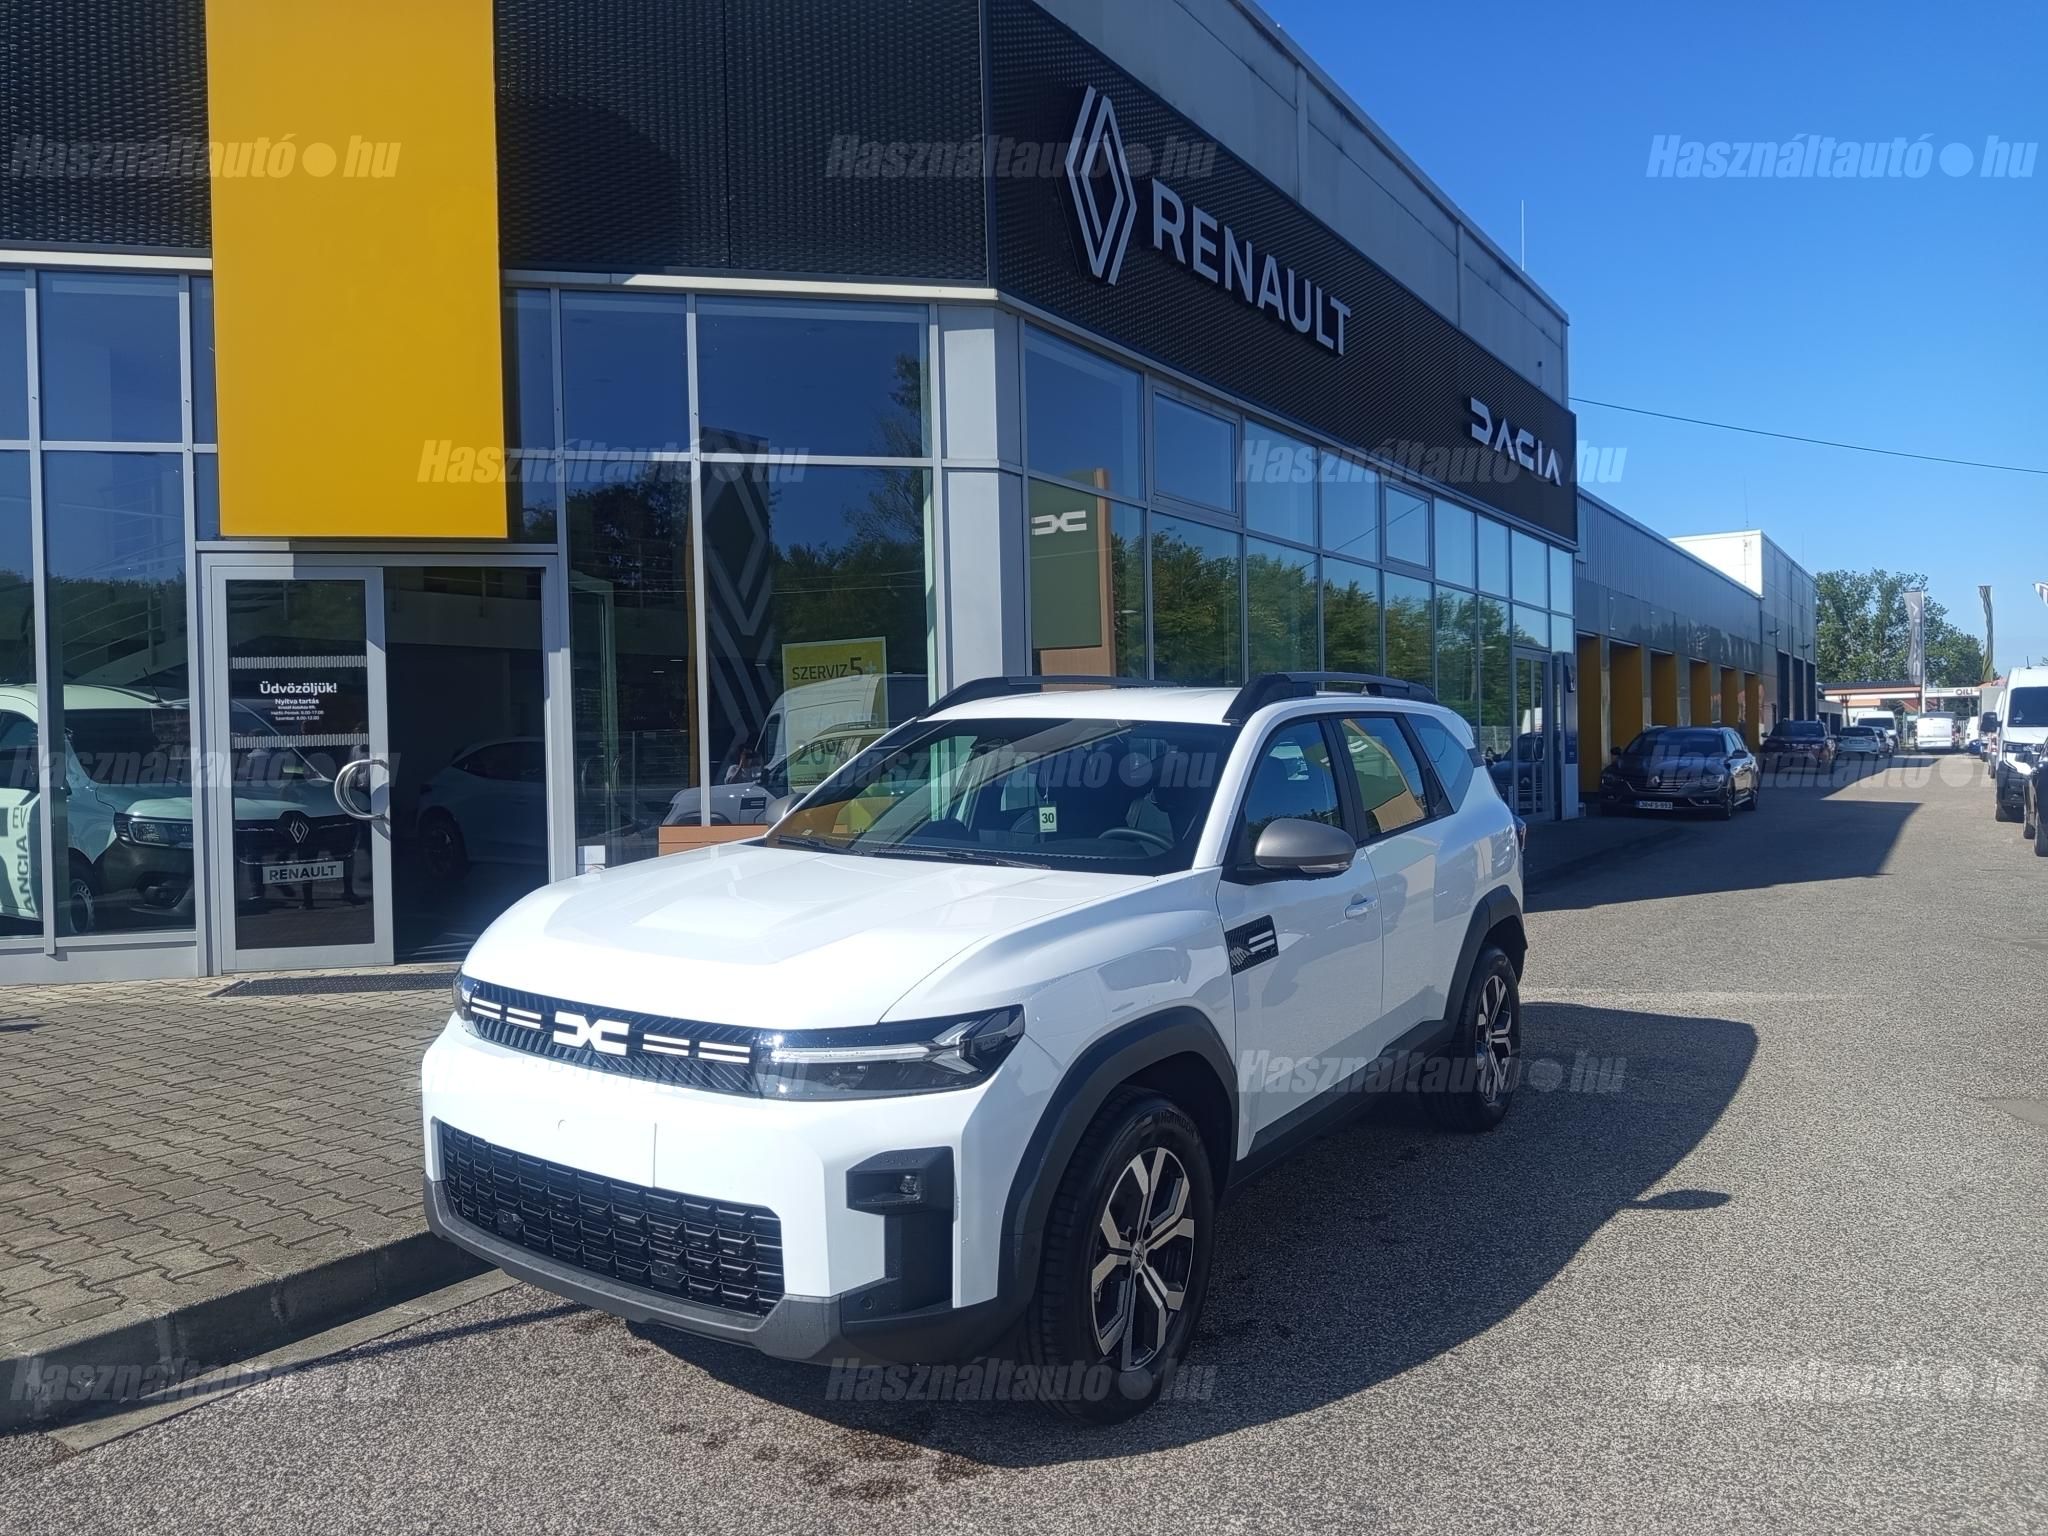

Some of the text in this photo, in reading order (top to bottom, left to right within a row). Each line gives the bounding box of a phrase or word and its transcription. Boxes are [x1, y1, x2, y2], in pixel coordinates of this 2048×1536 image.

[1152, 177, 1351, 355] RENAULT
[1471, 397, 1561, 487] DACIA
[792, 663, 848, 681] SZERVIZ
[260, 681, 337, 696] Üdvözöljük!
[275, 697, 320, 706] Nyitva tartás
[1041, 812, 1055, 824] 30
[269, 865, 337, 881] RENAULT
